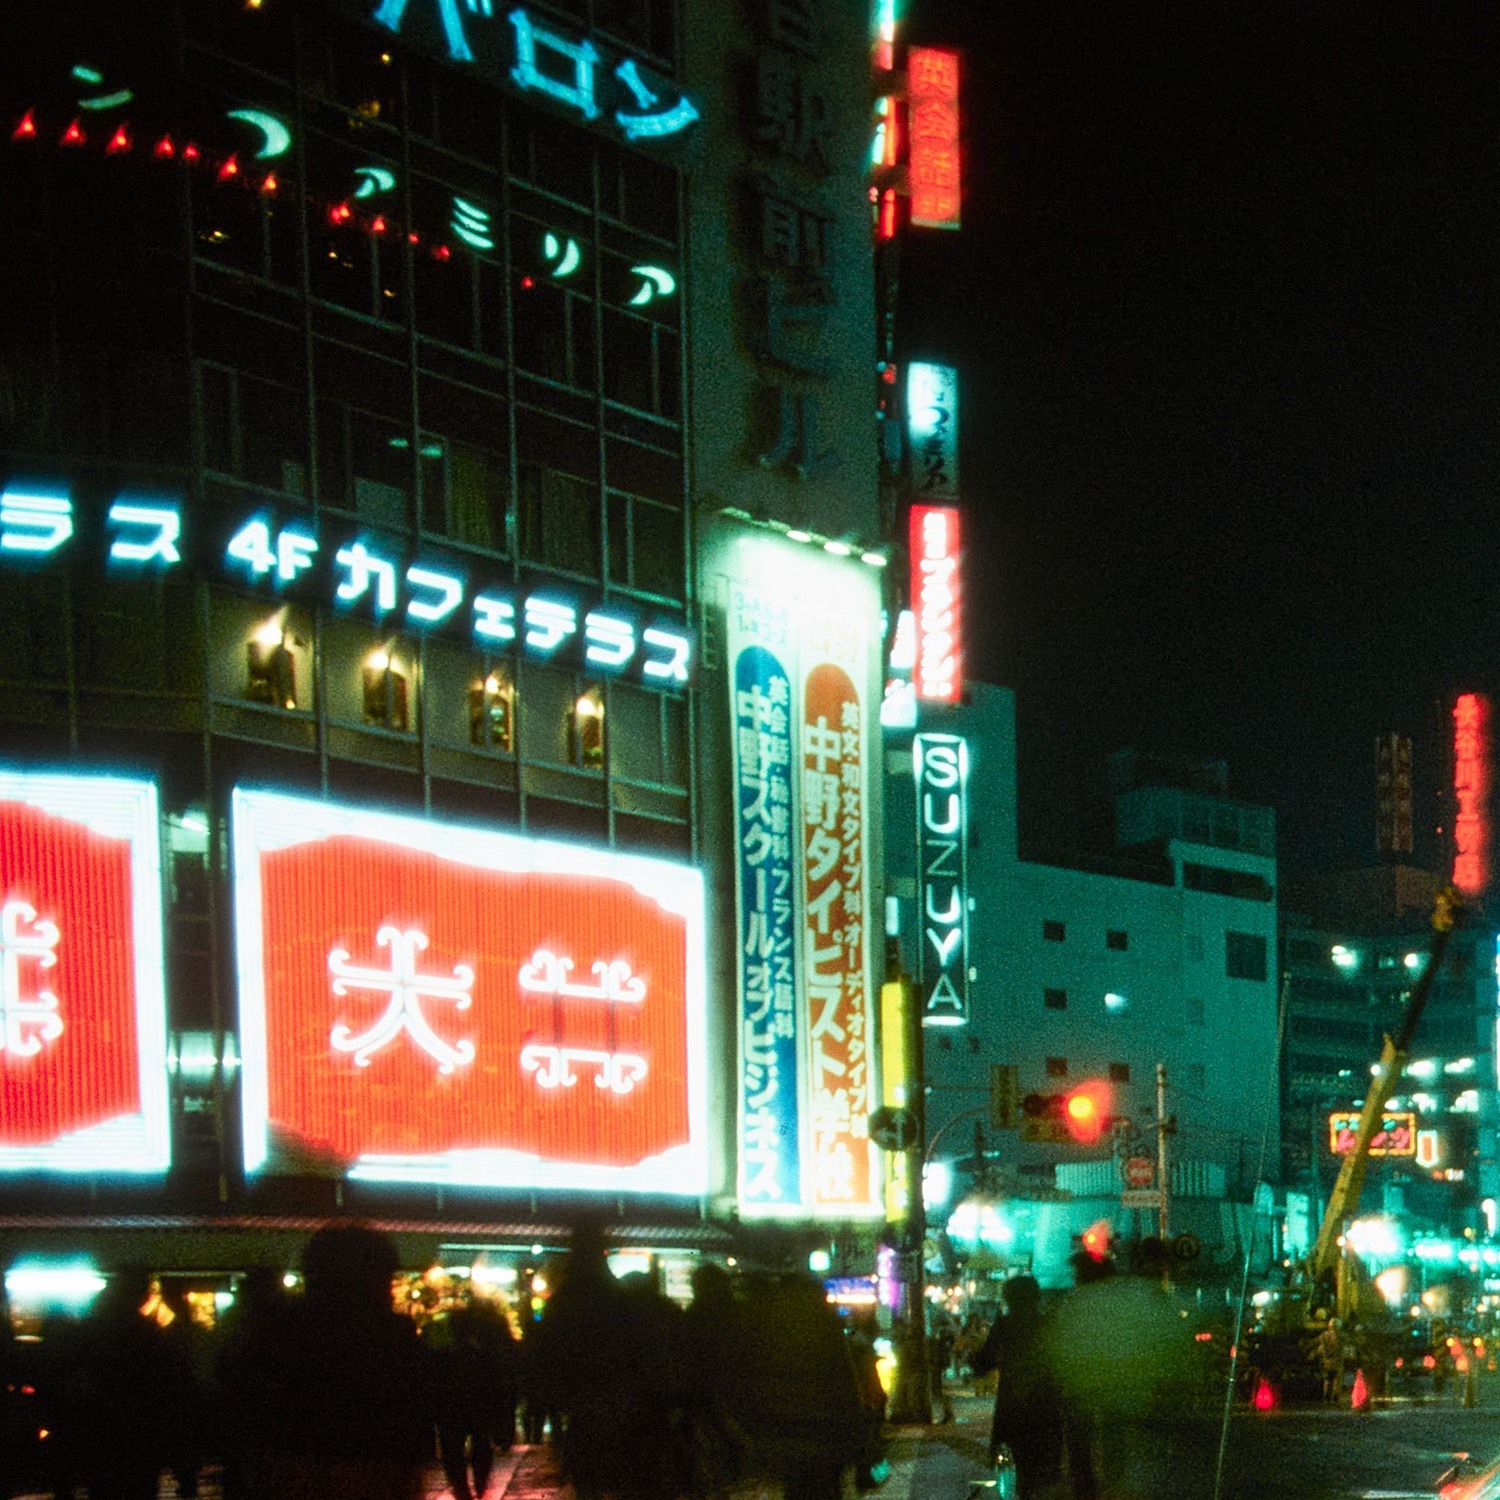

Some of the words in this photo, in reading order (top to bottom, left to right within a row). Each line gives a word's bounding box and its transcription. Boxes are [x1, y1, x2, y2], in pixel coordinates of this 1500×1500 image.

[228, 520, 319, 580] 4F
[335, 541, 690, 682] カフェテラス
[804, 714, 854, 1201] 中野タイピスト学校
[925, 742, 963, 1012] SUZUYA
